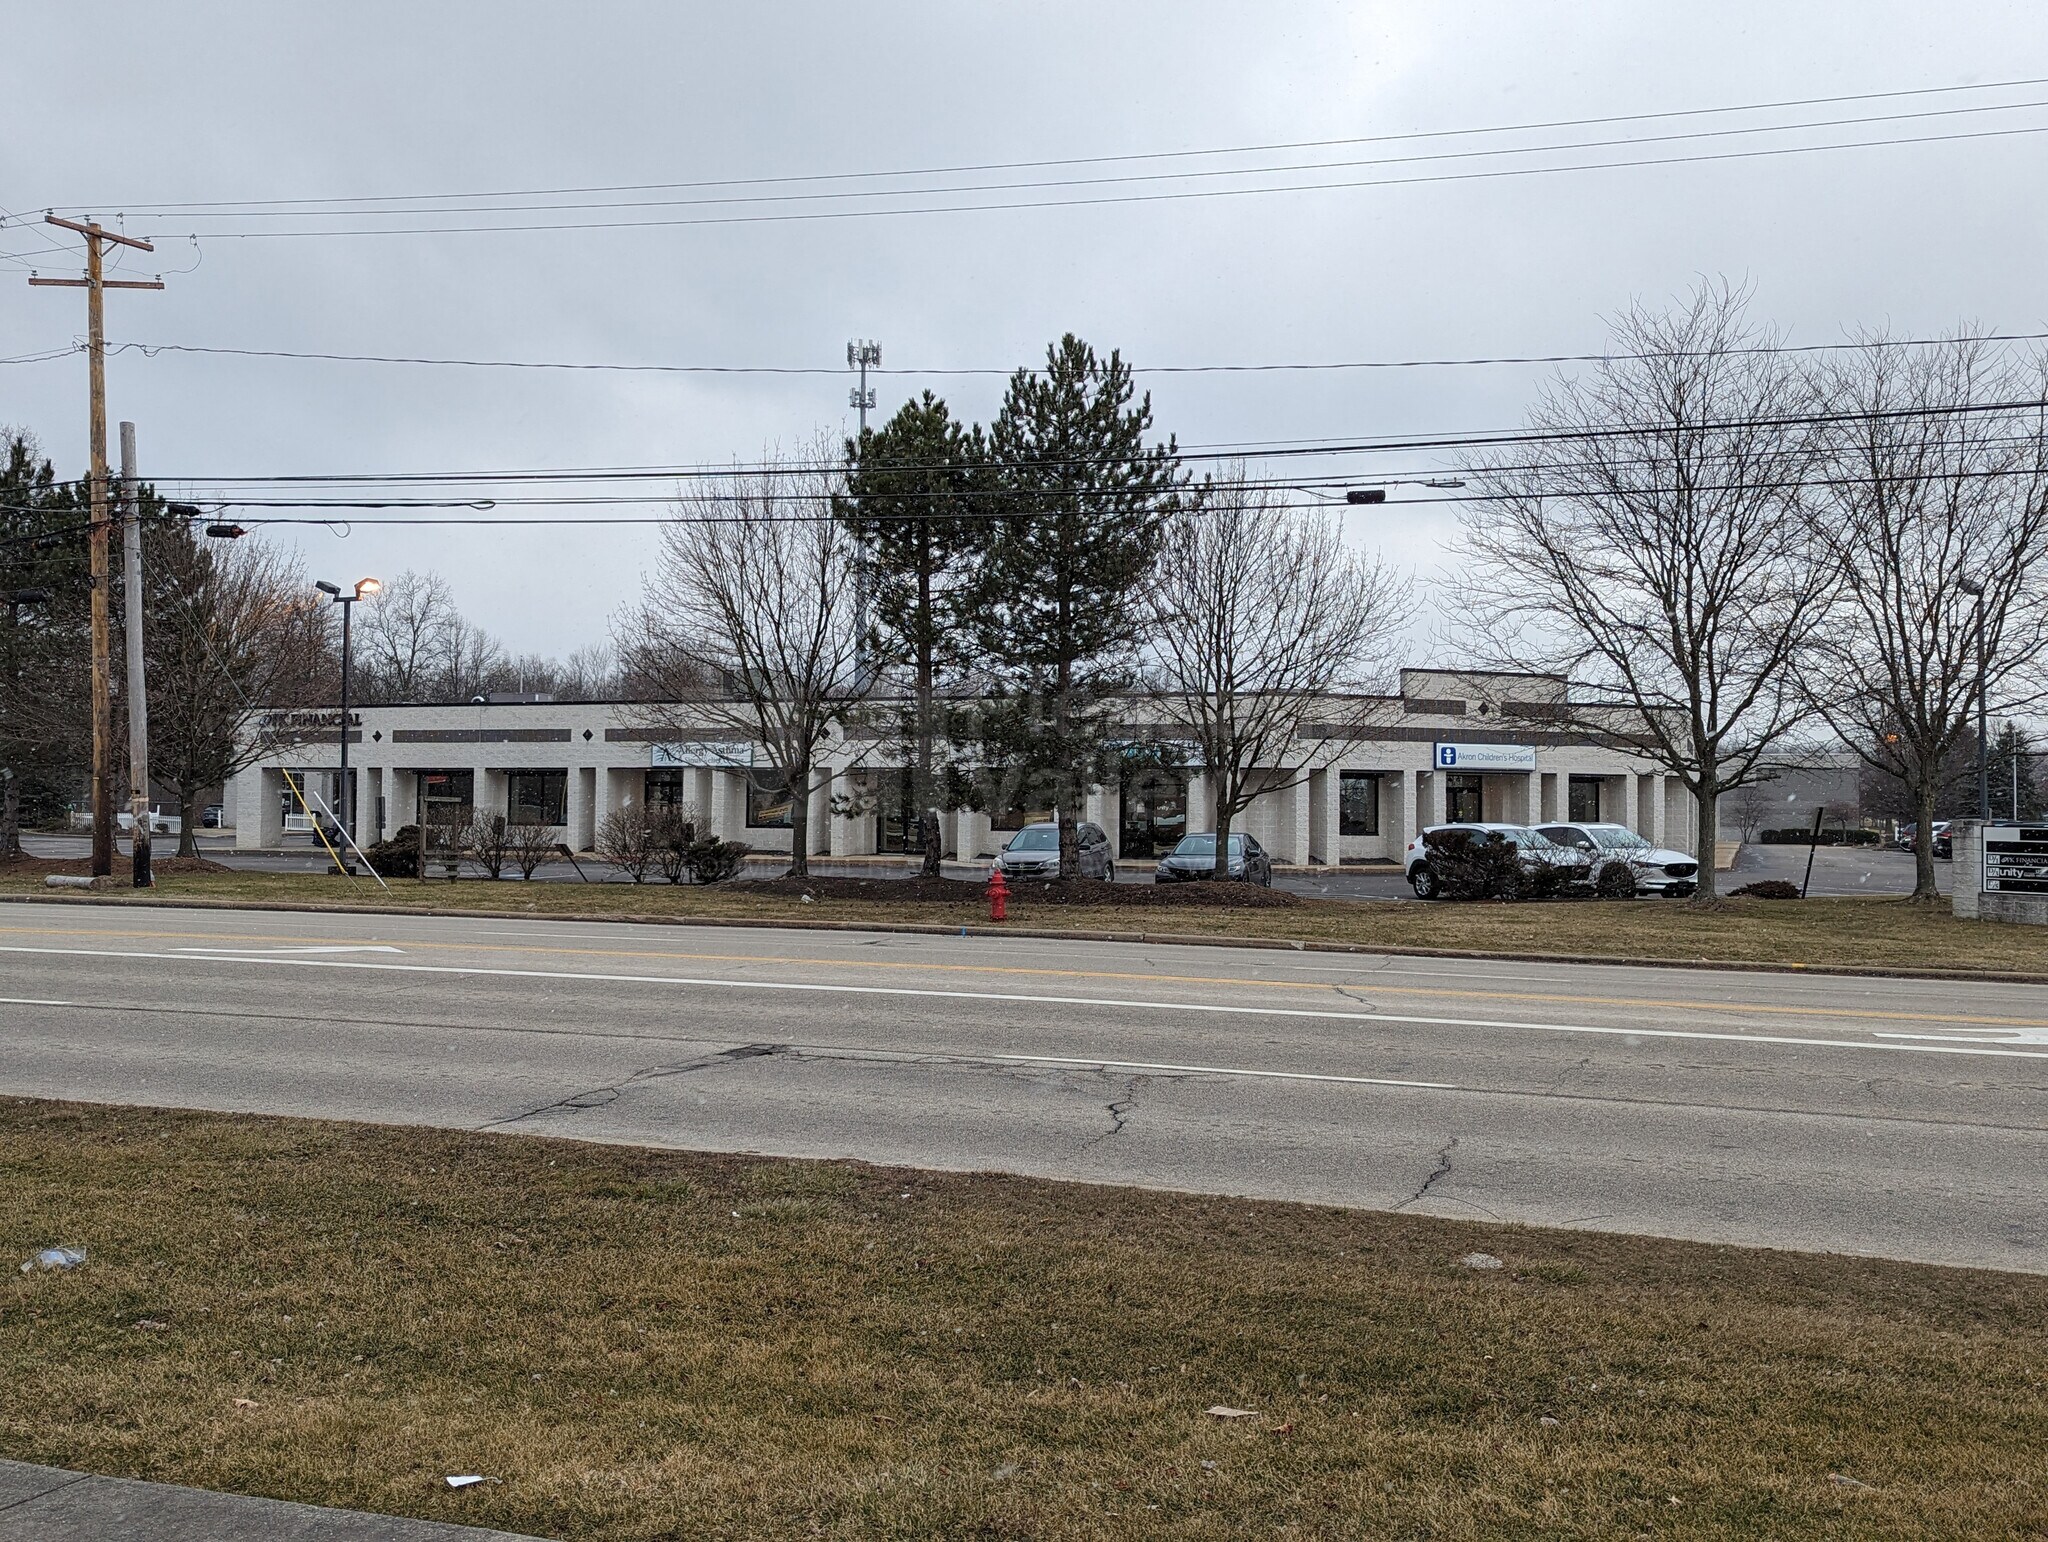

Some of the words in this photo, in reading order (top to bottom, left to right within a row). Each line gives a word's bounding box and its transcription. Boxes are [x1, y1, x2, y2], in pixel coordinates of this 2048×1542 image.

[290, 713, 362, 726] FINANCAL
[1457, 752, 1476, 761] Akron
[1477, 752, 1507, 762] Children's
[1508, 753, 1534, 763] Hospital
[1999, 868, 2024, 878] unity
